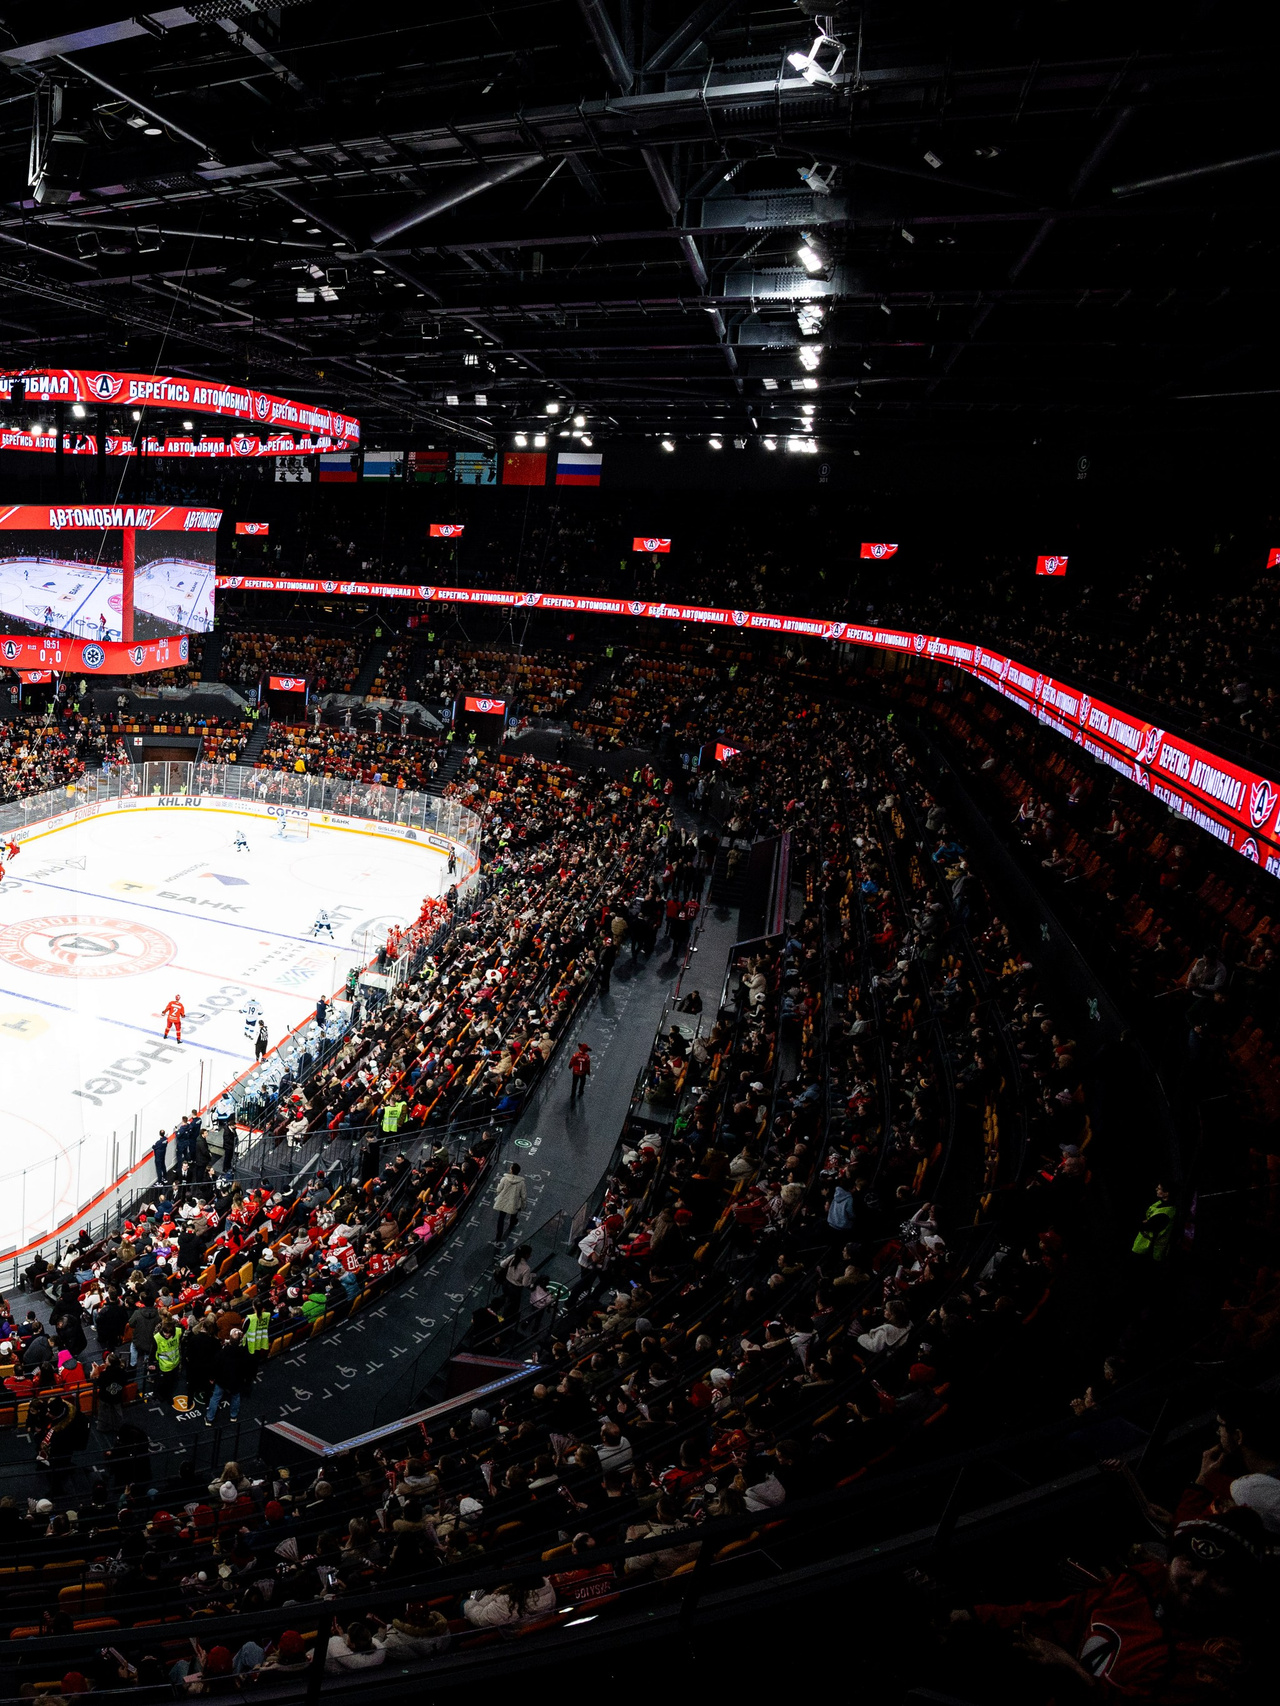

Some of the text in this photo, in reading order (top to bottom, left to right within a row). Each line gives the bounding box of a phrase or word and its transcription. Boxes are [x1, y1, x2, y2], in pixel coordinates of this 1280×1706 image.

[130, 380, 189, 402] БЕРЕГИСЬ
[193, 387, 248, 411] АВТОМОБИЛЯ
[2, 434, 32, 446] БЕРЕГИСЬ
[50, 508, 156, 528] АВТОМОБИЛИСТ
[751, 616, 781, 630] БЕРЕГИСЬ
[847, 628, 873, 642] БЕРЕГИСЬ
[43, 640, 59, 649] 19:51
[40, 650, 46, 661] 0
[55, 650, 62, 662] 0
[1159, 744, 1190, 779] БЕРЕГИСЬ
[1190, 760, 1241, 809] АВТОМОБИЛЯ
[158, 797, 202, 807] KHL.RU
[74, 804, 101, 821] FONBET
[156, 891, 245, 913] БАНК
[172, 1007, 179, 1017] 2
[248, 1007, 256, 1015] 19
[72, 1039, 187, 1107] Haier
[186, 1410, 201, 1419] 103
